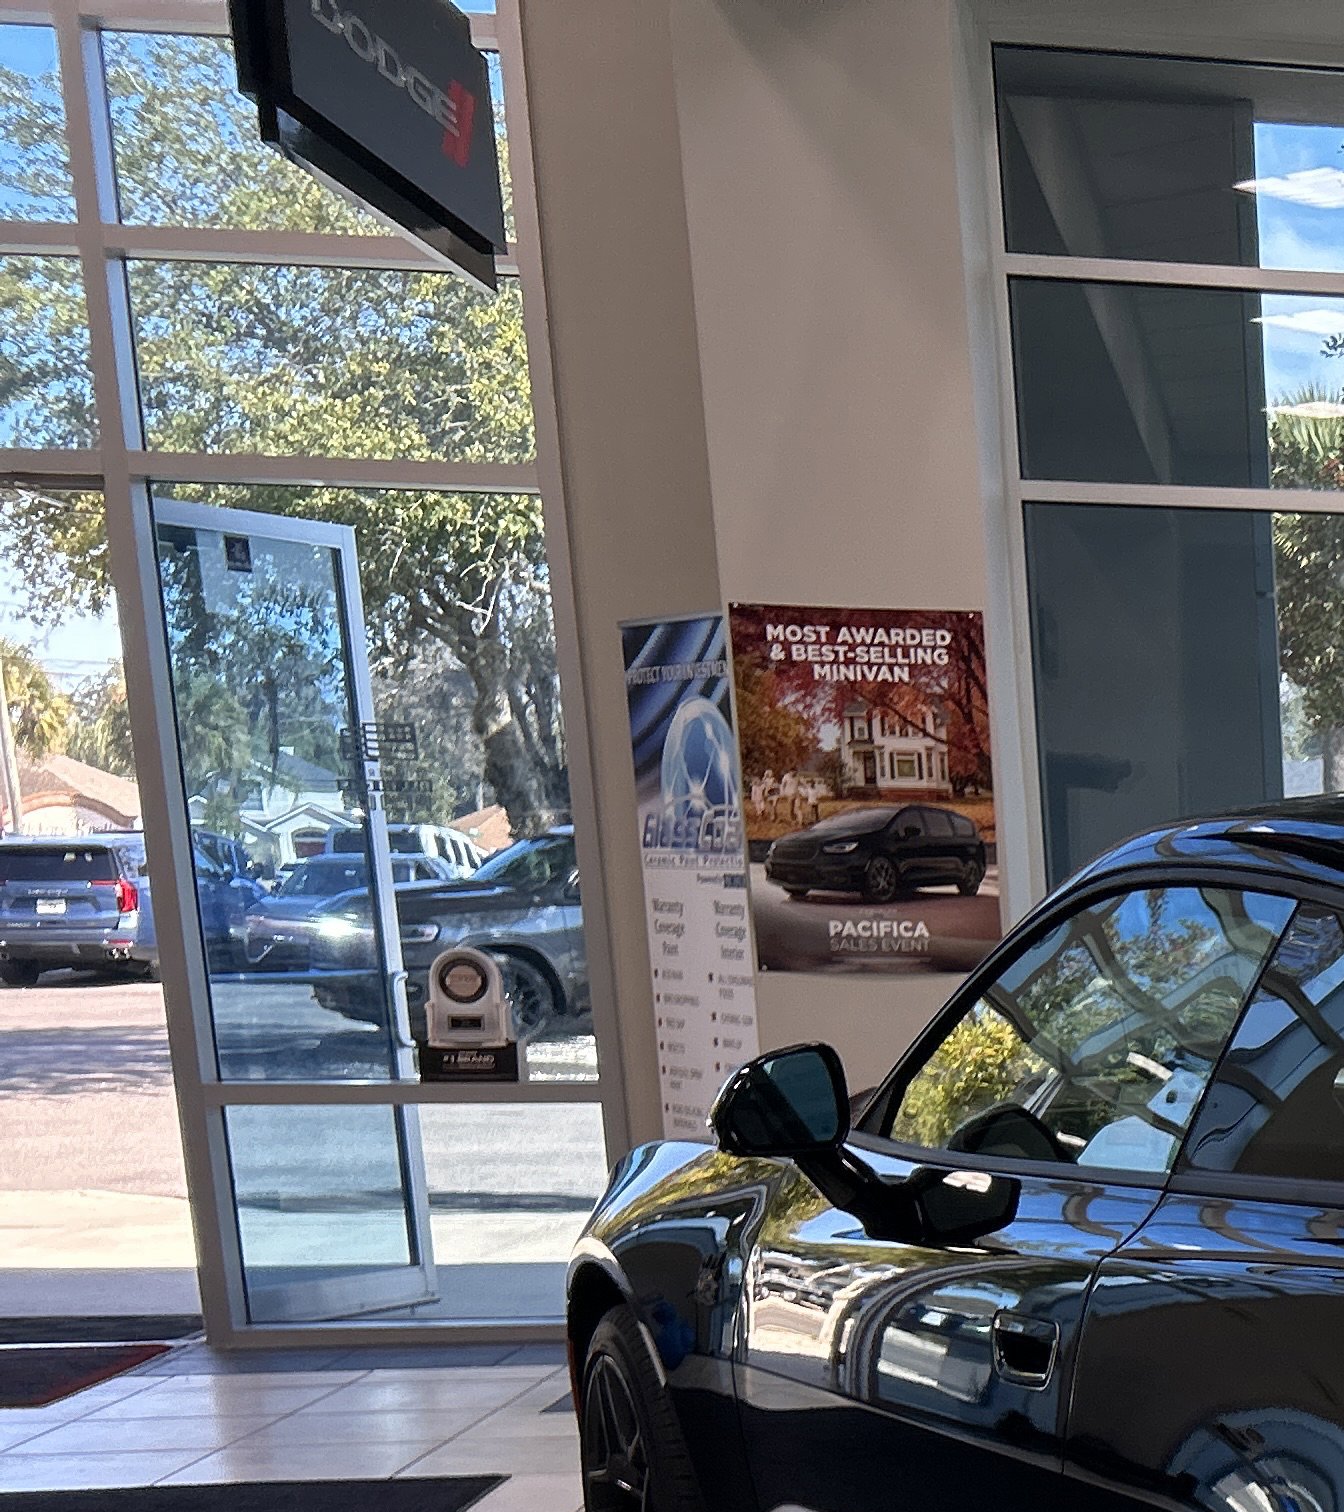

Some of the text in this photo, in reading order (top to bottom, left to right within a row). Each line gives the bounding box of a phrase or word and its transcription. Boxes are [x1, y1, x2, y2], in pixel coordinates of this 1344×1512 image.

[765, 624, 952, 646] MOST AWARDED
[770, 643, 949, 665] & BEST-SELLING
[813, 664, 911, 683] MINIVAN
[654, 919, 685, 938] Coverage
[715, 921, 746, 943] Coverage
[829, 920, 930, 938] PACIFICA
[830, 938, 930, 952] SALES EVENT
